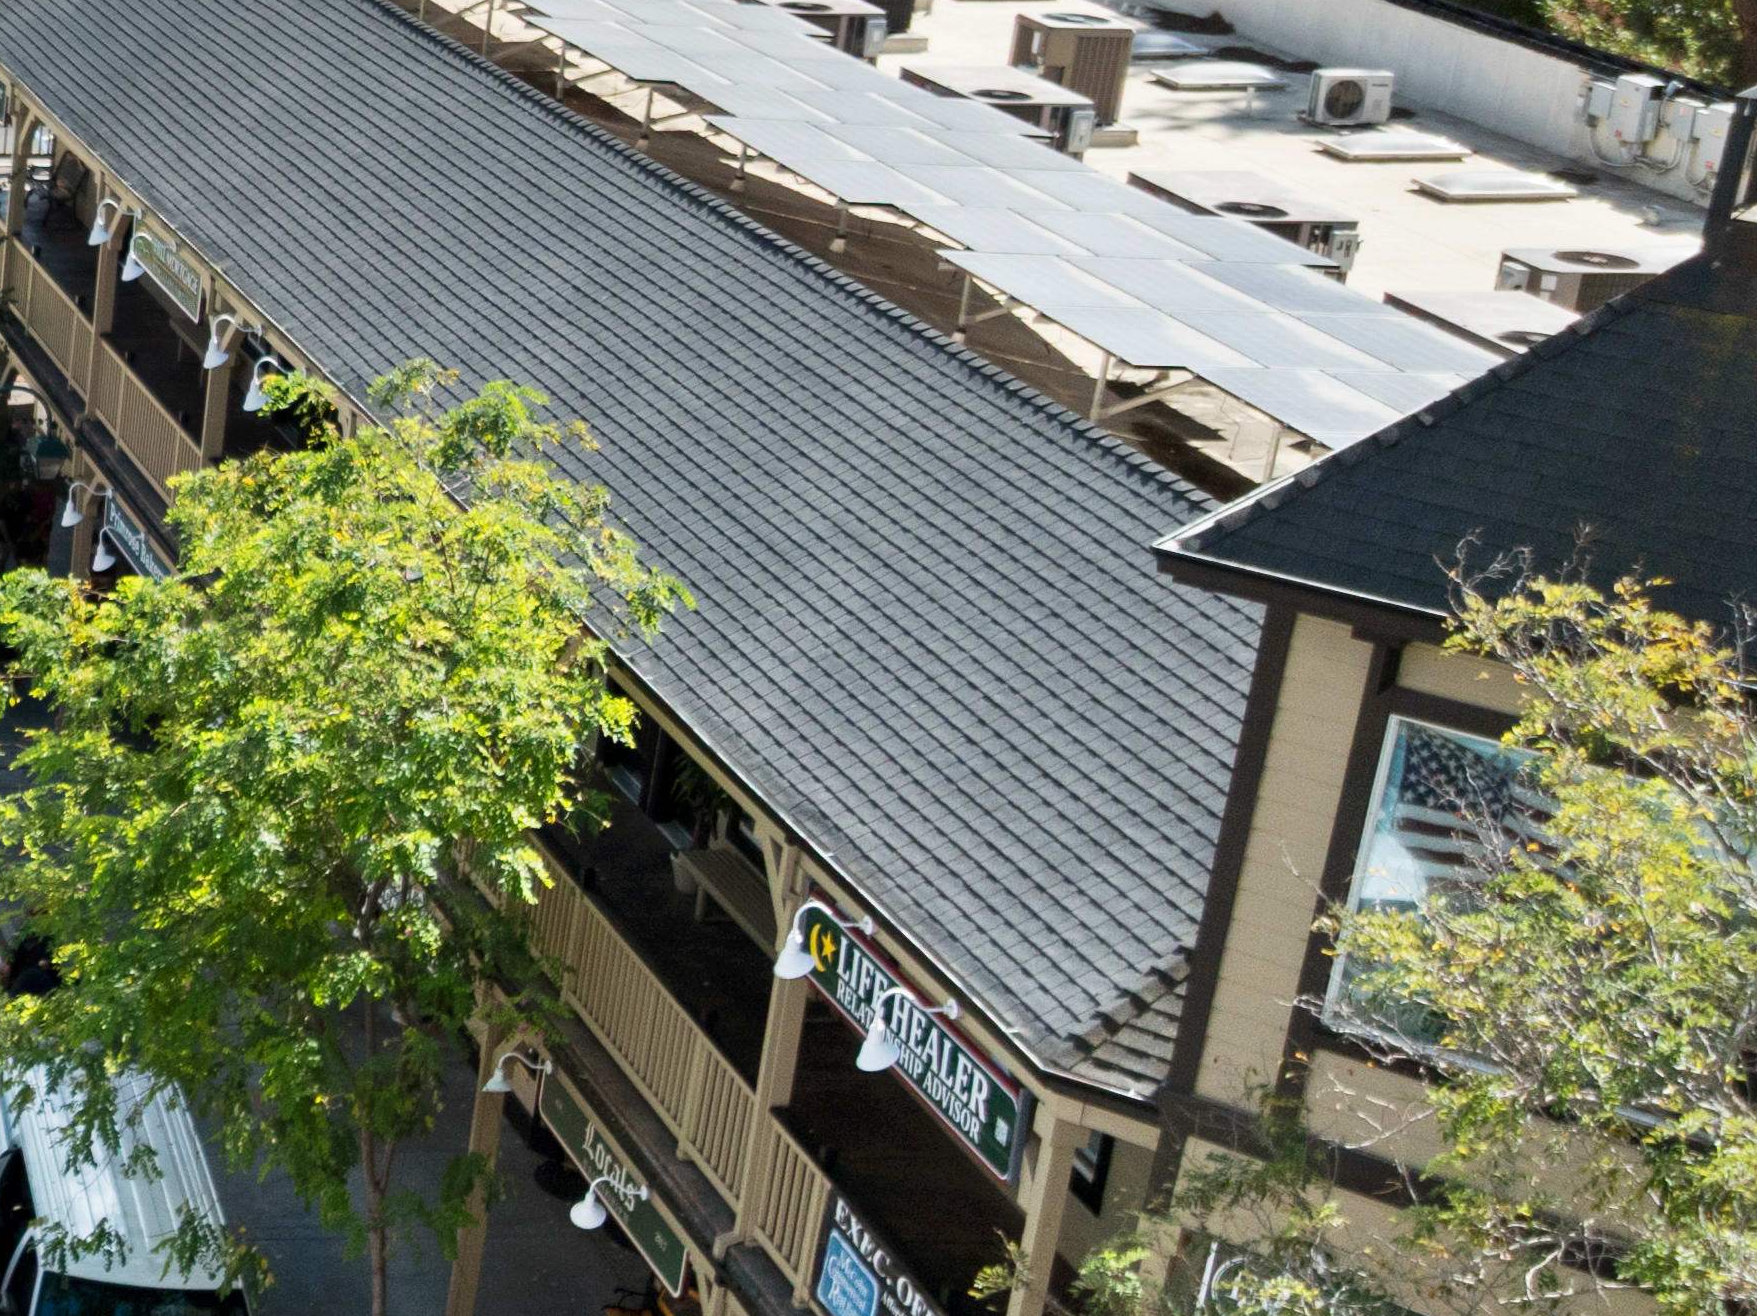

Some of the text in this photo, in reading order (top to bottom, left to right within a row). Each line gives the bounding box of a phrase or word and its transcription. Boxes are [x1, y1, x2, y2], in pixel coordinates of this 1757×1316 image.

[835, 977, 983, 1145] RELATNSHIP ADVISOR
[836, 935, 990, 1123] LIFE HEALER
[582, 1121, 635, 1212] Locals
[834, 1195, 892, 1285] EXEC.
